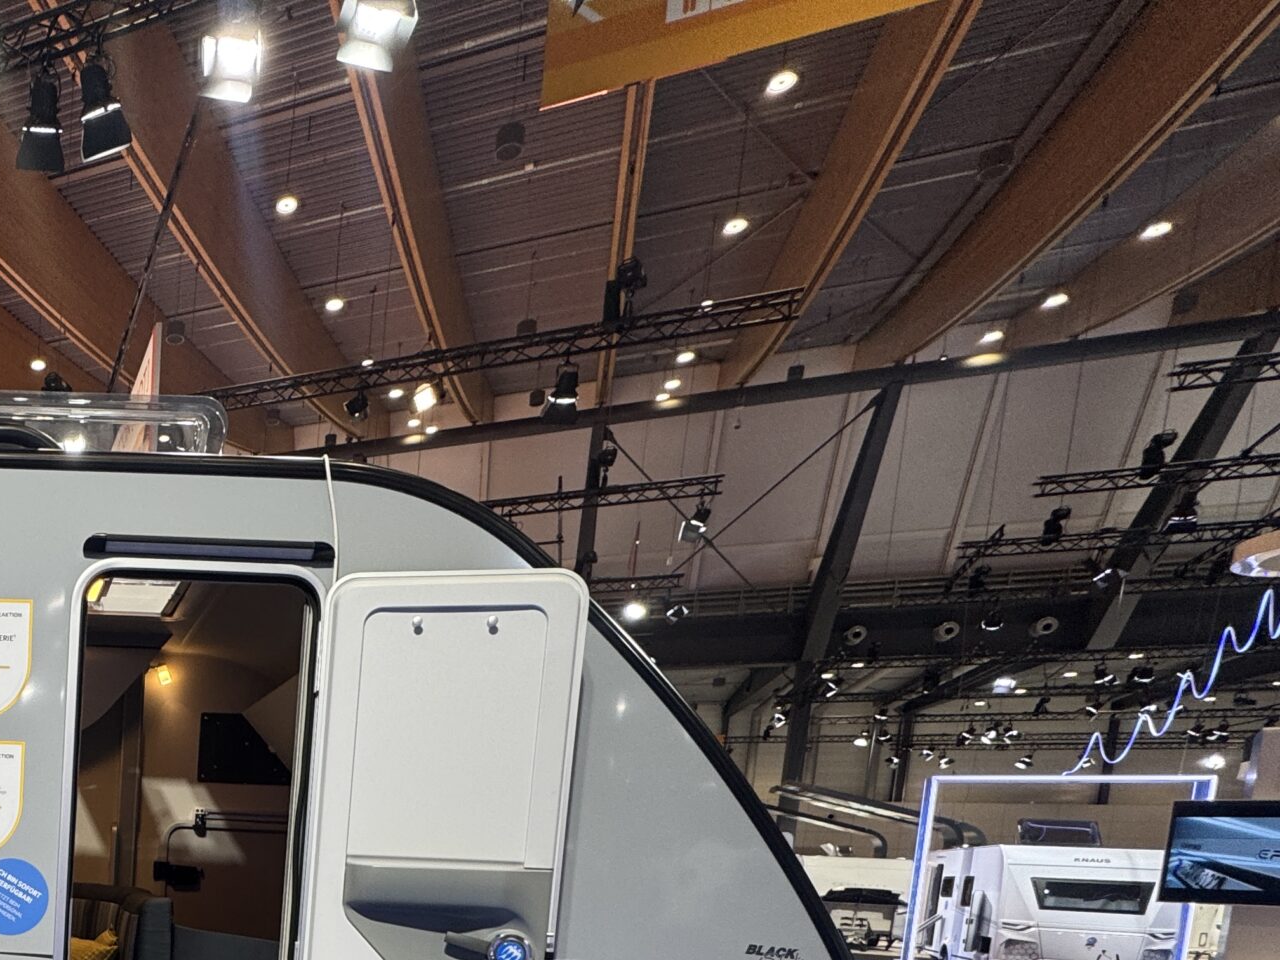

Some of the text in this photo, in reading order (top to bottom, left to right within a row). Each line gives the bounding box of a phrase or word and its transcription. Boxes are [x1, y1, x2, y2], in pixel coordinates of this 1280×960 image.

[7, 874, 18, 885] BIN
[18, 880, 42, 898] SOFORT
[745, 944, 800, 959] BLACK
